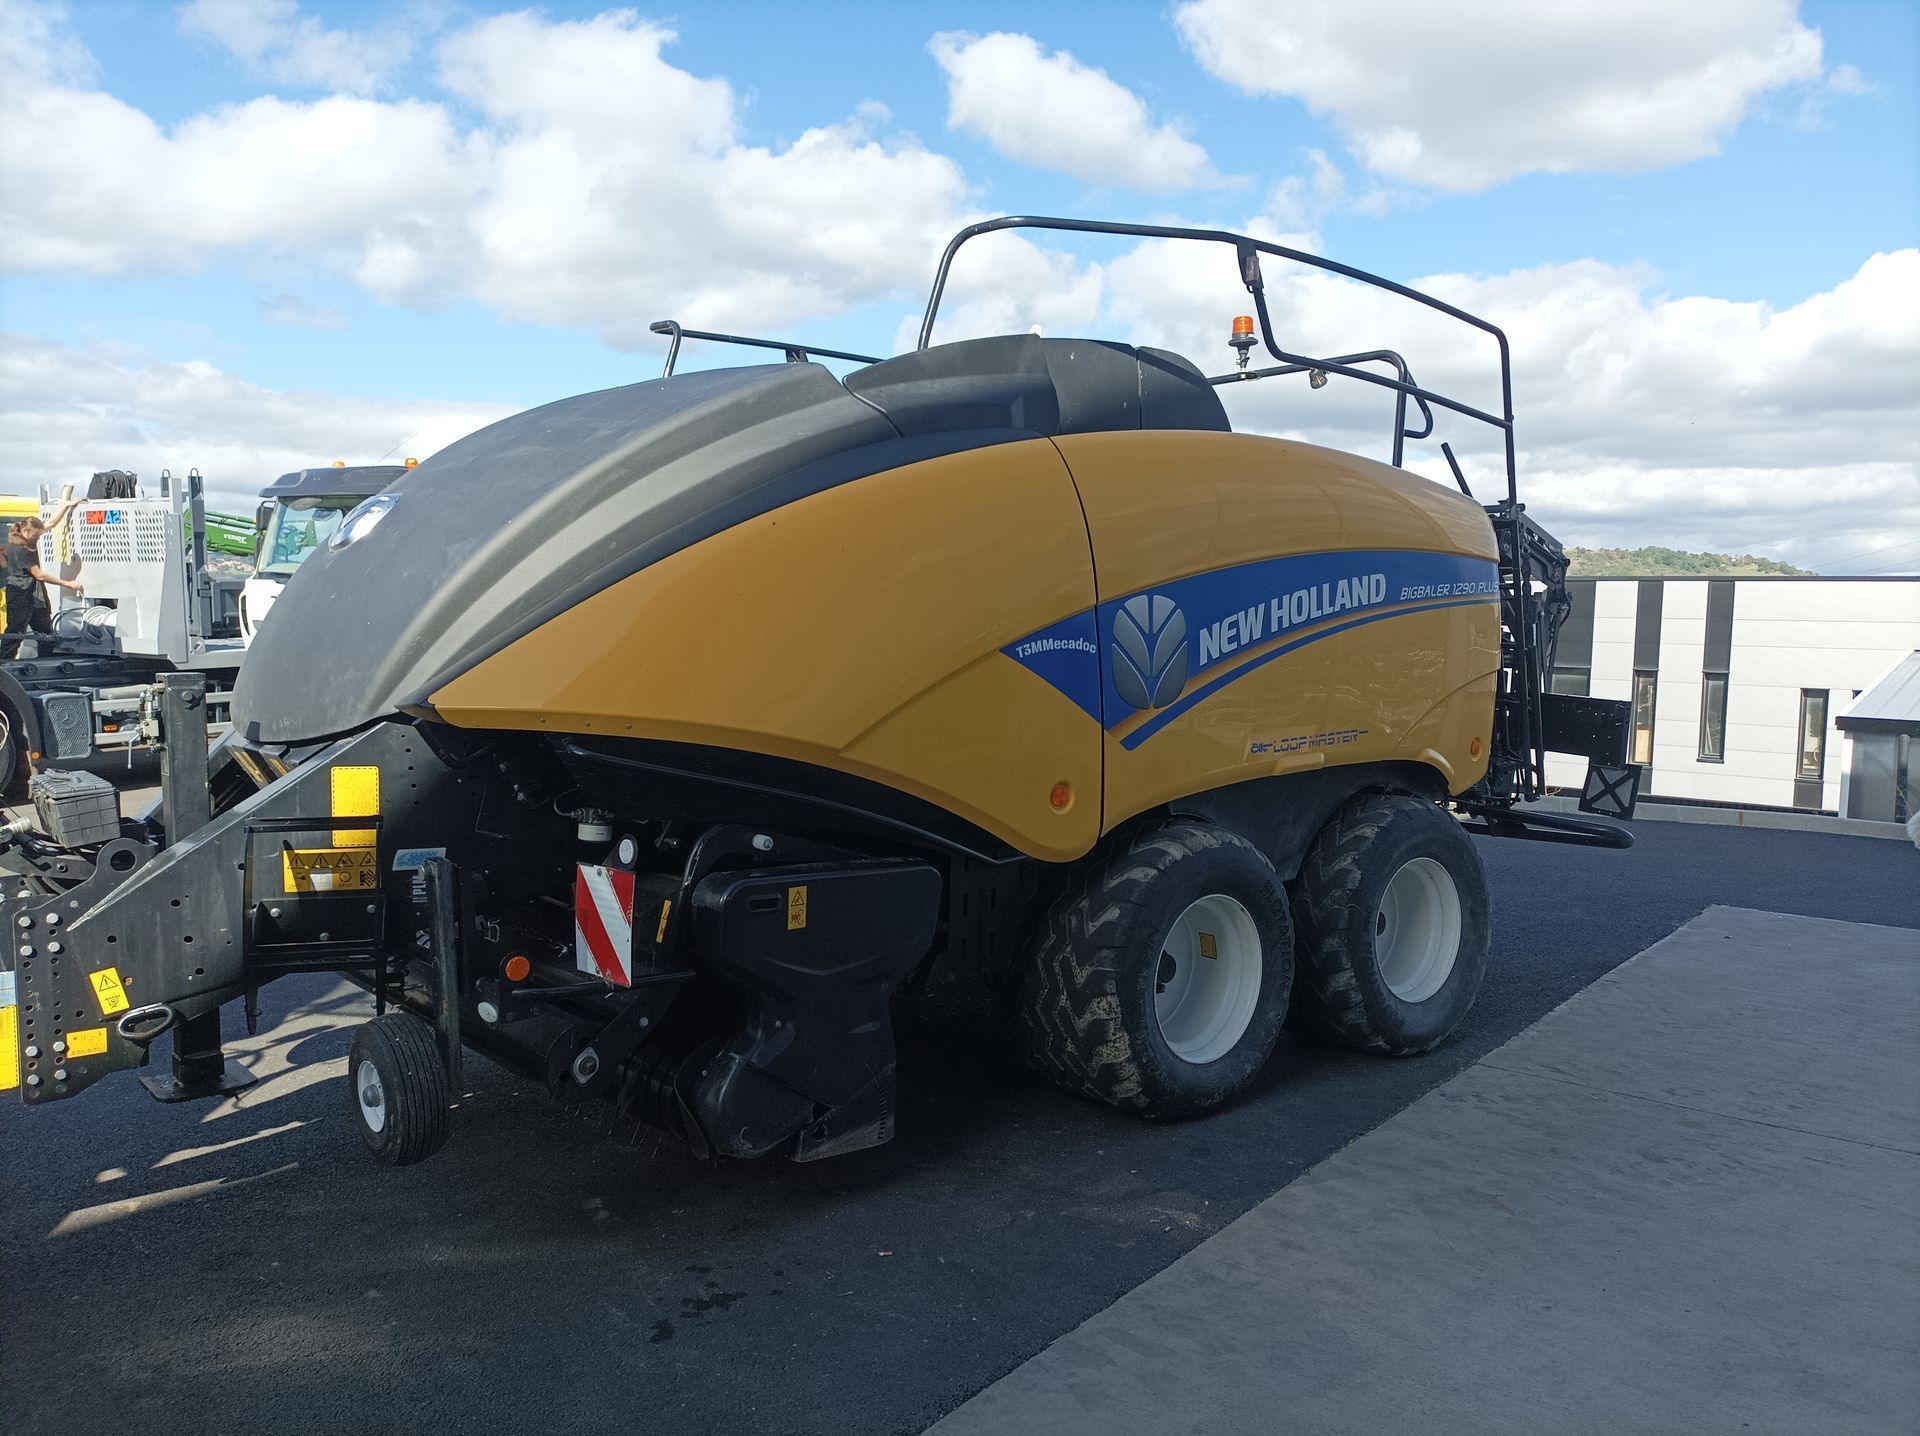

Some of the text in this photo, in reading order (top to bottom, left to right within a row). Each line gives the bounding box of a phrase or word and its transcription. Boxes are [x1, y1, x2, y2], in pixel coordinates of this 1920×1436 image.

[223, 533, 247, 543] FENDT
[1399, 580, 1500, 601] BIGBALER 1290 PLUS
[1199, 573, 1387, 667] NEW HOLLAND
